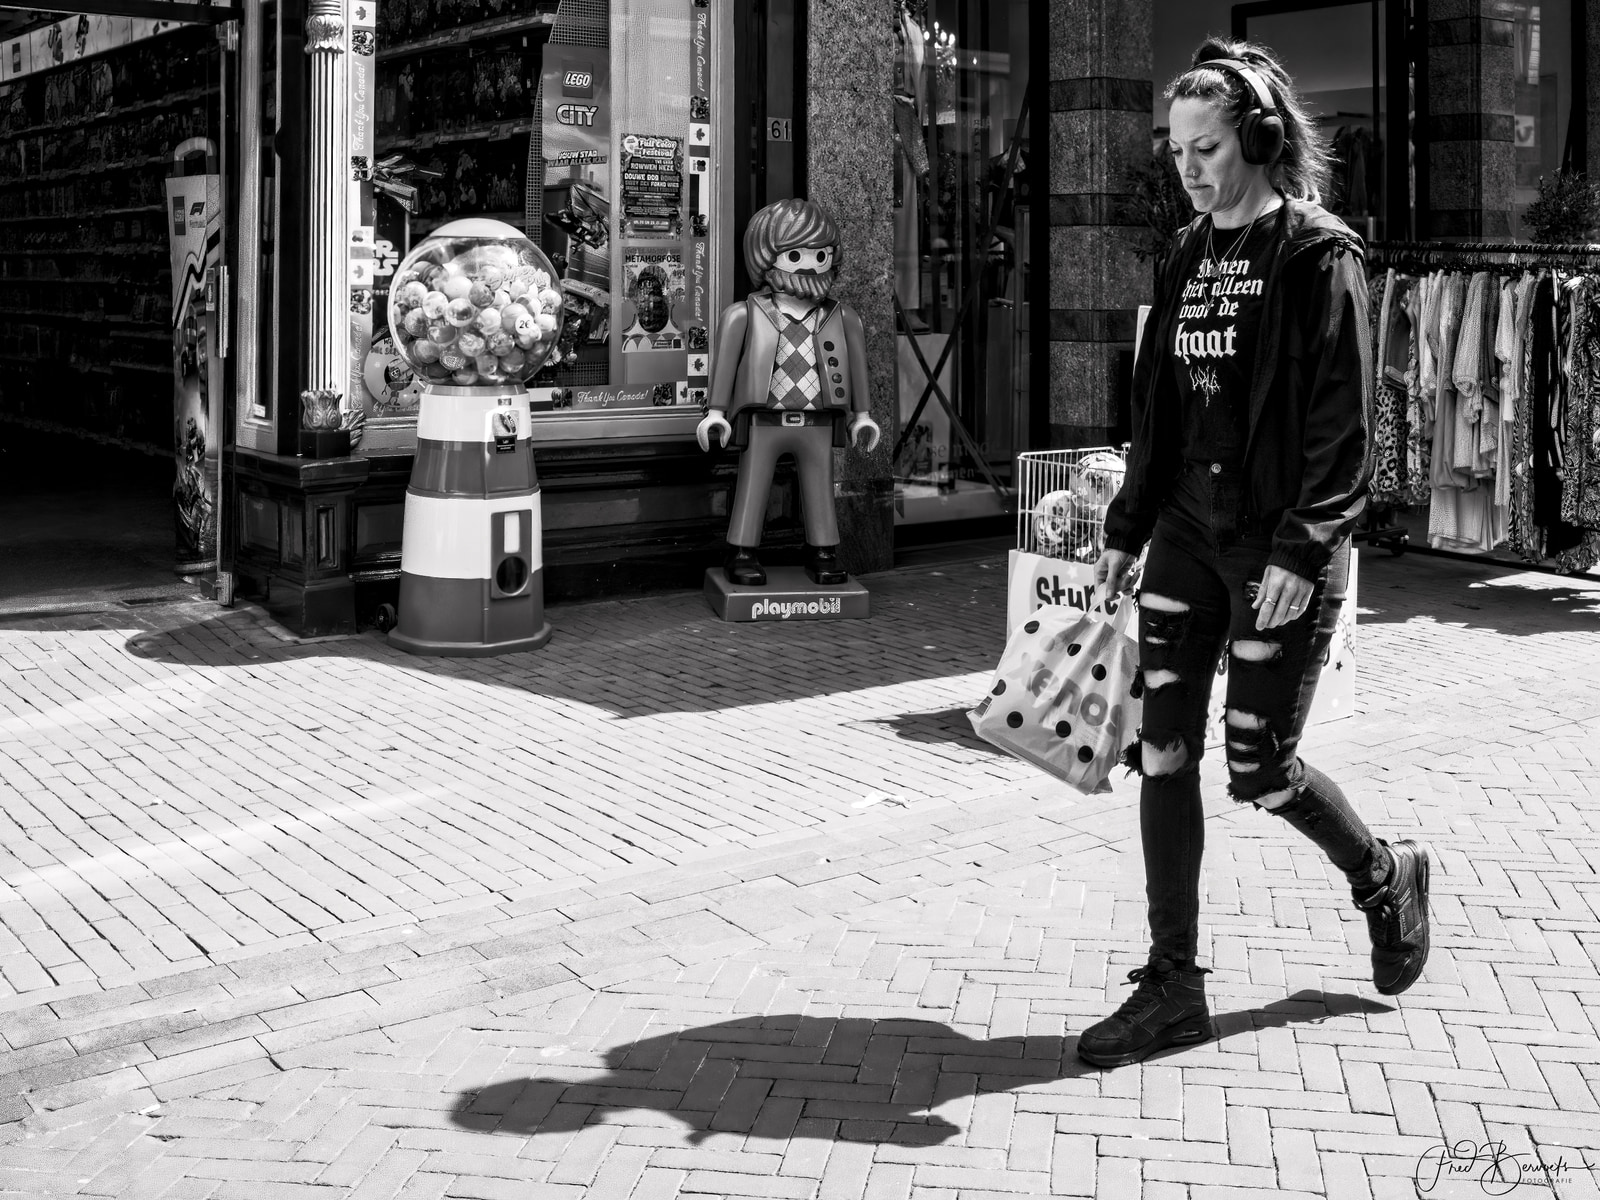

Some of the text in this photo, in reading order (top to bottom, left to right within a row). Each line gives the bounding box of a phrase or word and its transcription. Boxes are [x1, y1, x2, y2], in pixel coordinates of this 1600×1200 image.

[564, 71, 591, 88] LEGO
[556, 104, 598, 127] CITY
[771, 120, 789, 140] 61
[580, 150, 598, 158] STAD
[625, 254, 681, 263] METAMORFOSE
[1182, 276, 1263, 302] hier alleen
[1217, 297, 1239, 317] de
[1174, 321, 1237, 365] haat
[577, 390, 648, 406] Thank You Canada!
[751, 597, 841, 619] playmobil
